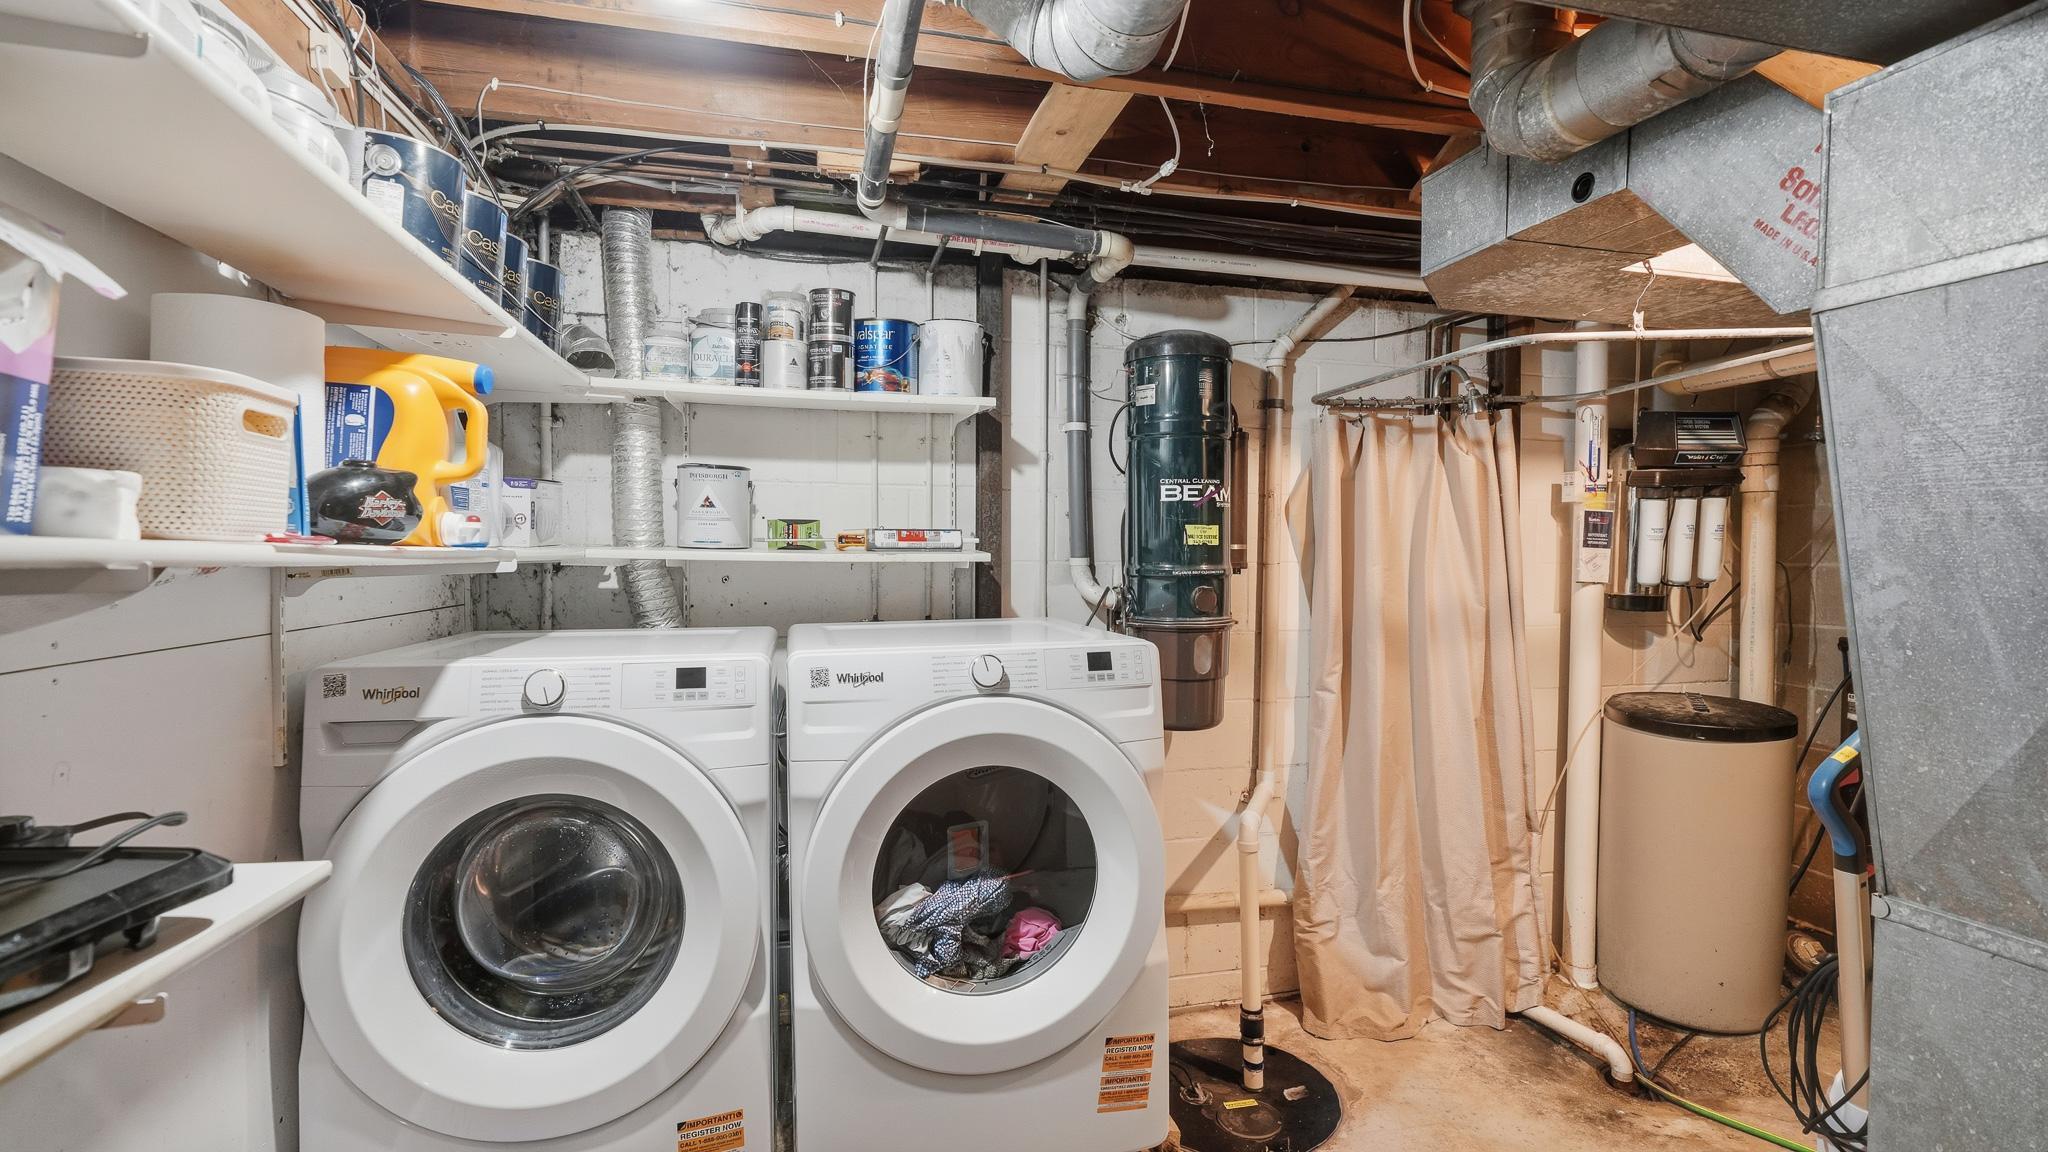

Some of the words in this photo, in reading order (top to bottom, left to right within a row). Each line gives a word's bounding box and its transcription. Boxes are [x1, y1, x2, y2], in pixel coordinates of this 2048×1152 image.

[1753, 218, 1781, 241] MADE
[1160, 484, 1231, 502] BEAM
[836, 671, 885, 686] Whirlpool
[361, 686, 421, 702] Whirlpool
[1106, 1045, 1137, 1054] REGISTER
[680, 1126, 721, 1141] REGISTER
[722, 1120, 742, 1131] NOW
[680, 1140, 697, 1149] CALL
